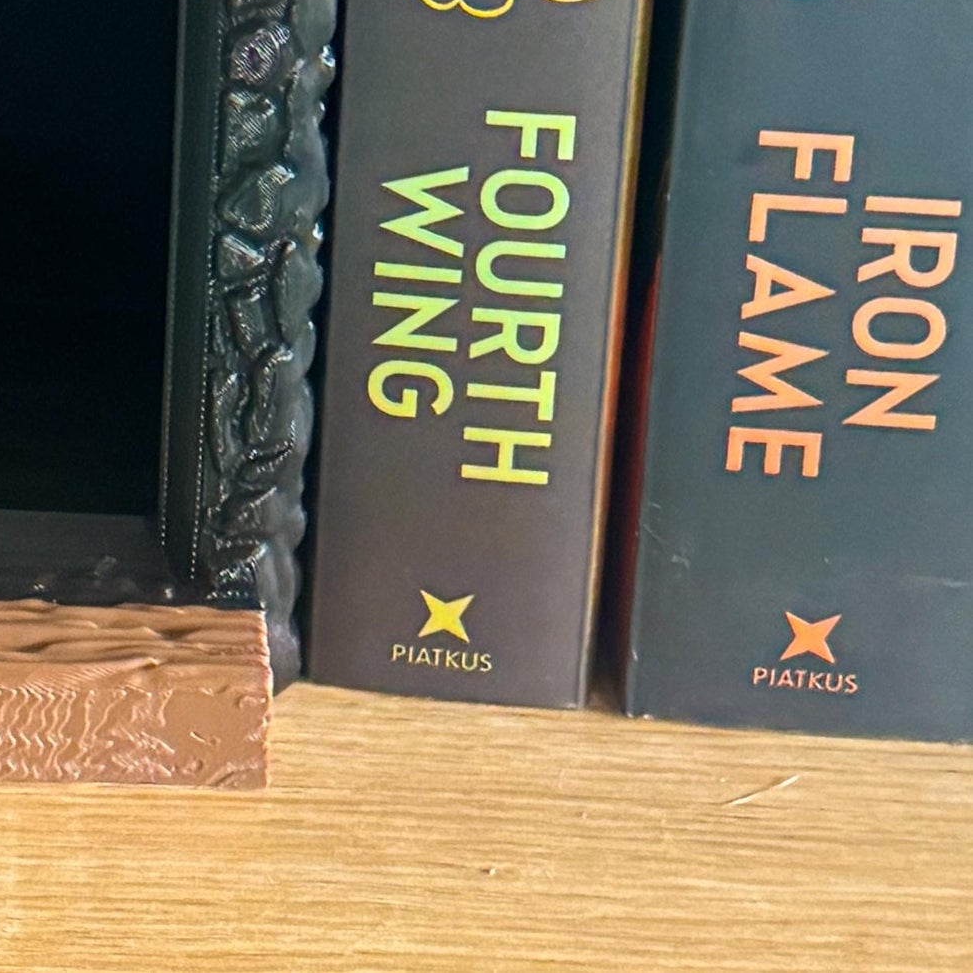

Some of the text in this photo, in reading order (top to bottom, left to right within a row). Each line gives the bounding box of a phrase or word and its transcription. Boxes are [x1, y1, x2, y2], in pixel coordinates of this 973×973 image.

[367, 166, 470, 419] WING
[461, 110, 577, 486] FOURTH
[726, 130, 855, 478] FLAME
[842, 195, 962, 431] IRON
[391, 643, 493, 673] PIATKUS
[752, 666, 859, 694] PIATKUS
